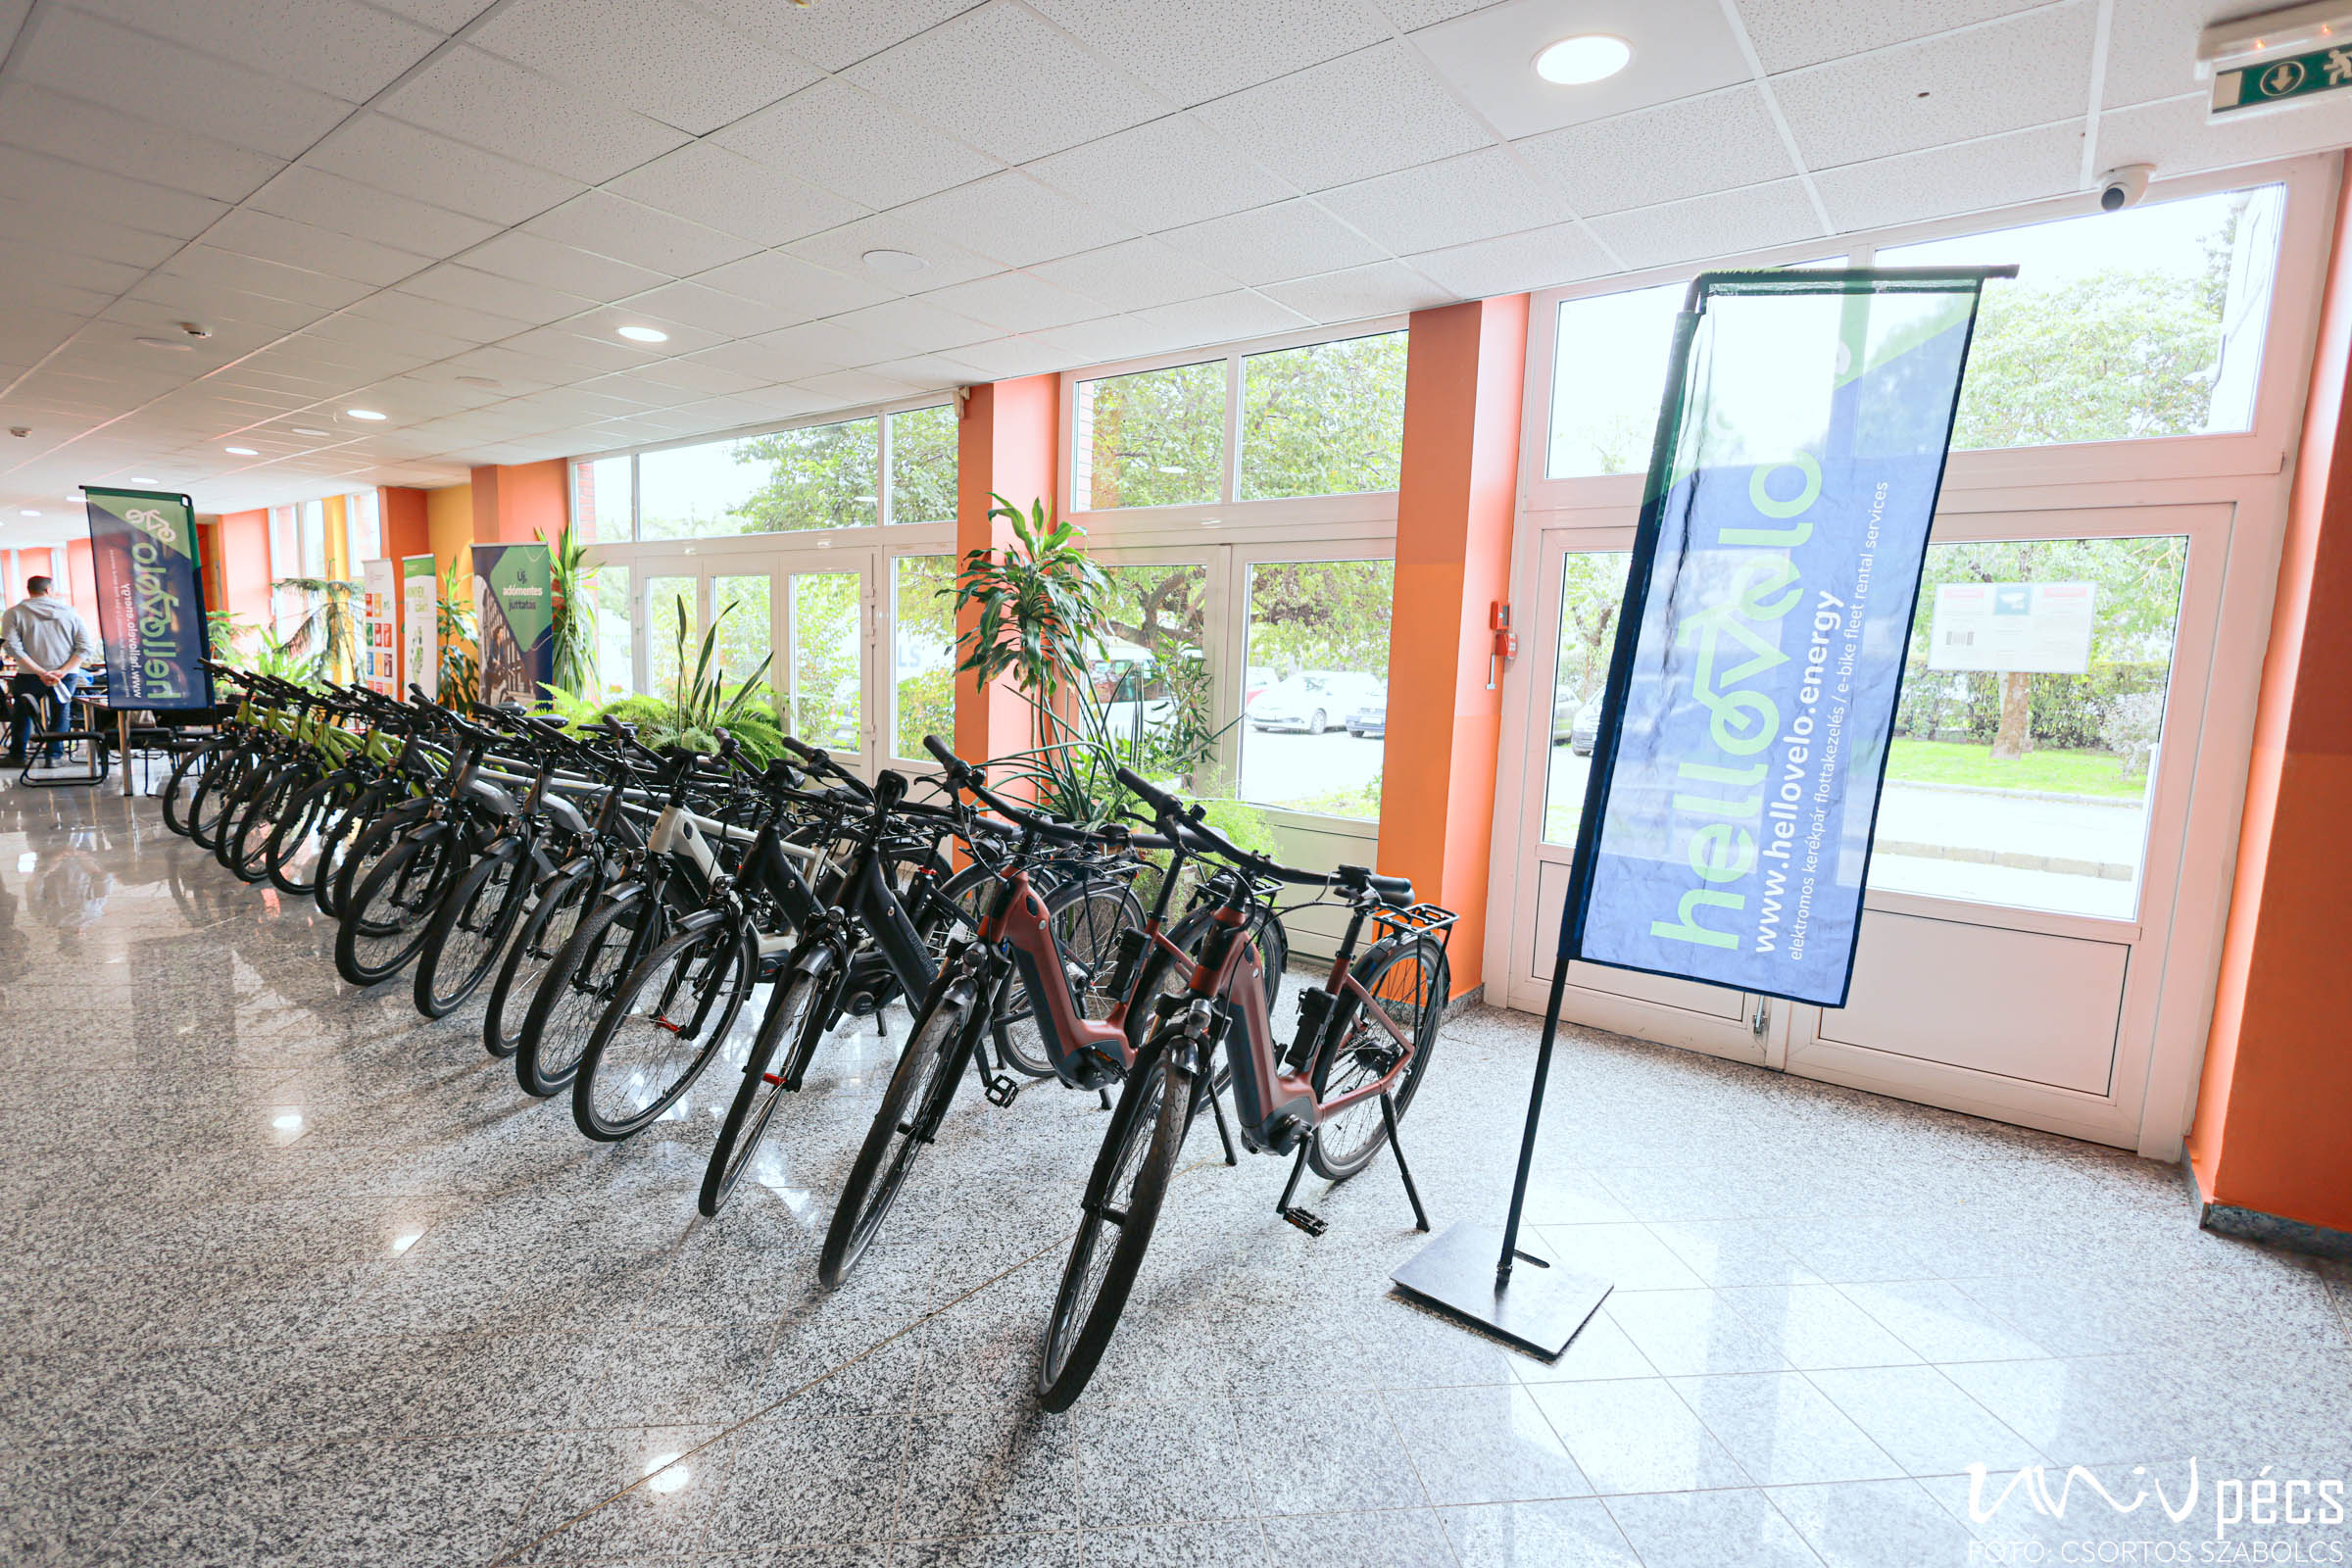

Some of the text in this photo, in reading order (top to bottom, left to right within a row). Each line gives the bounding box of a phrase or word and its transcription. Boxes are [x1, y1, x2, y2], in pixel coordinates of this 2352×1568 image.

[502, 584, 543, 596] adómentes
[1649, 452, 1822, 951] hellovelo
[1755, 590, 1844, 954] www.hellovelo.energy
[1788, 481, 1888, 961] elektromos kerékpár flottakezelés / e-bike fleet rental services
